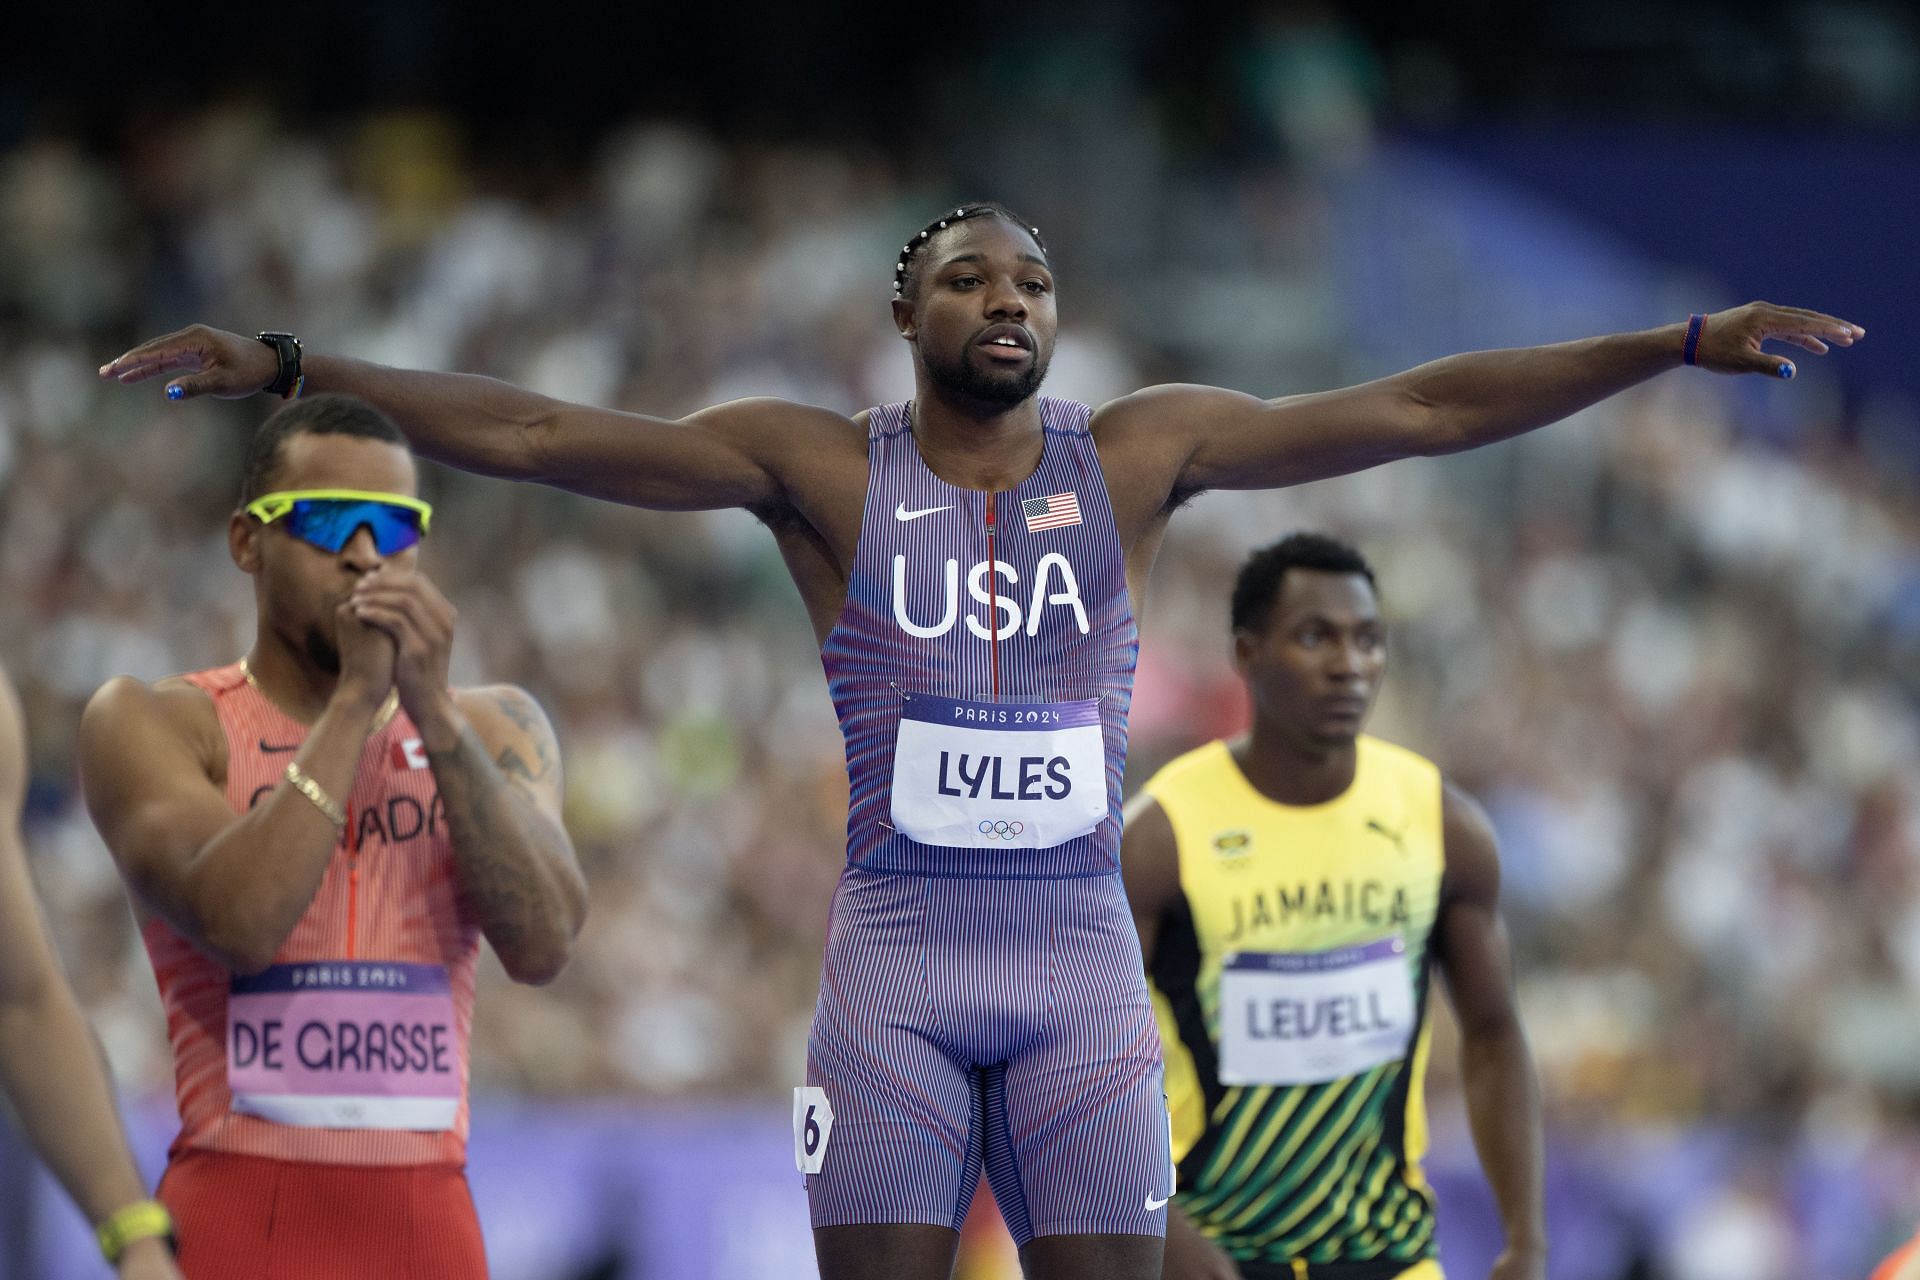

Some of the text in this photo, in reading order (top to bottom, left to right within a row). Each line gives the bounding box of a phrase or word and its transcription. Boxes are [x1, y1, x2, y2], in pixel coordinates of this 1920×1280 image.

[893, 552, 1090, 641] USA
[954, 706, 1061, 724] PARIS 2024
[938, 750, 1072, 801] LYLES
[1226, 879, 1412, 943] JAMAICA
[291, 966, 353, 987] PARIS
[233, 1019, 451, 1073] DE GRASSE
[804, 1104, 820, 1157] 6
